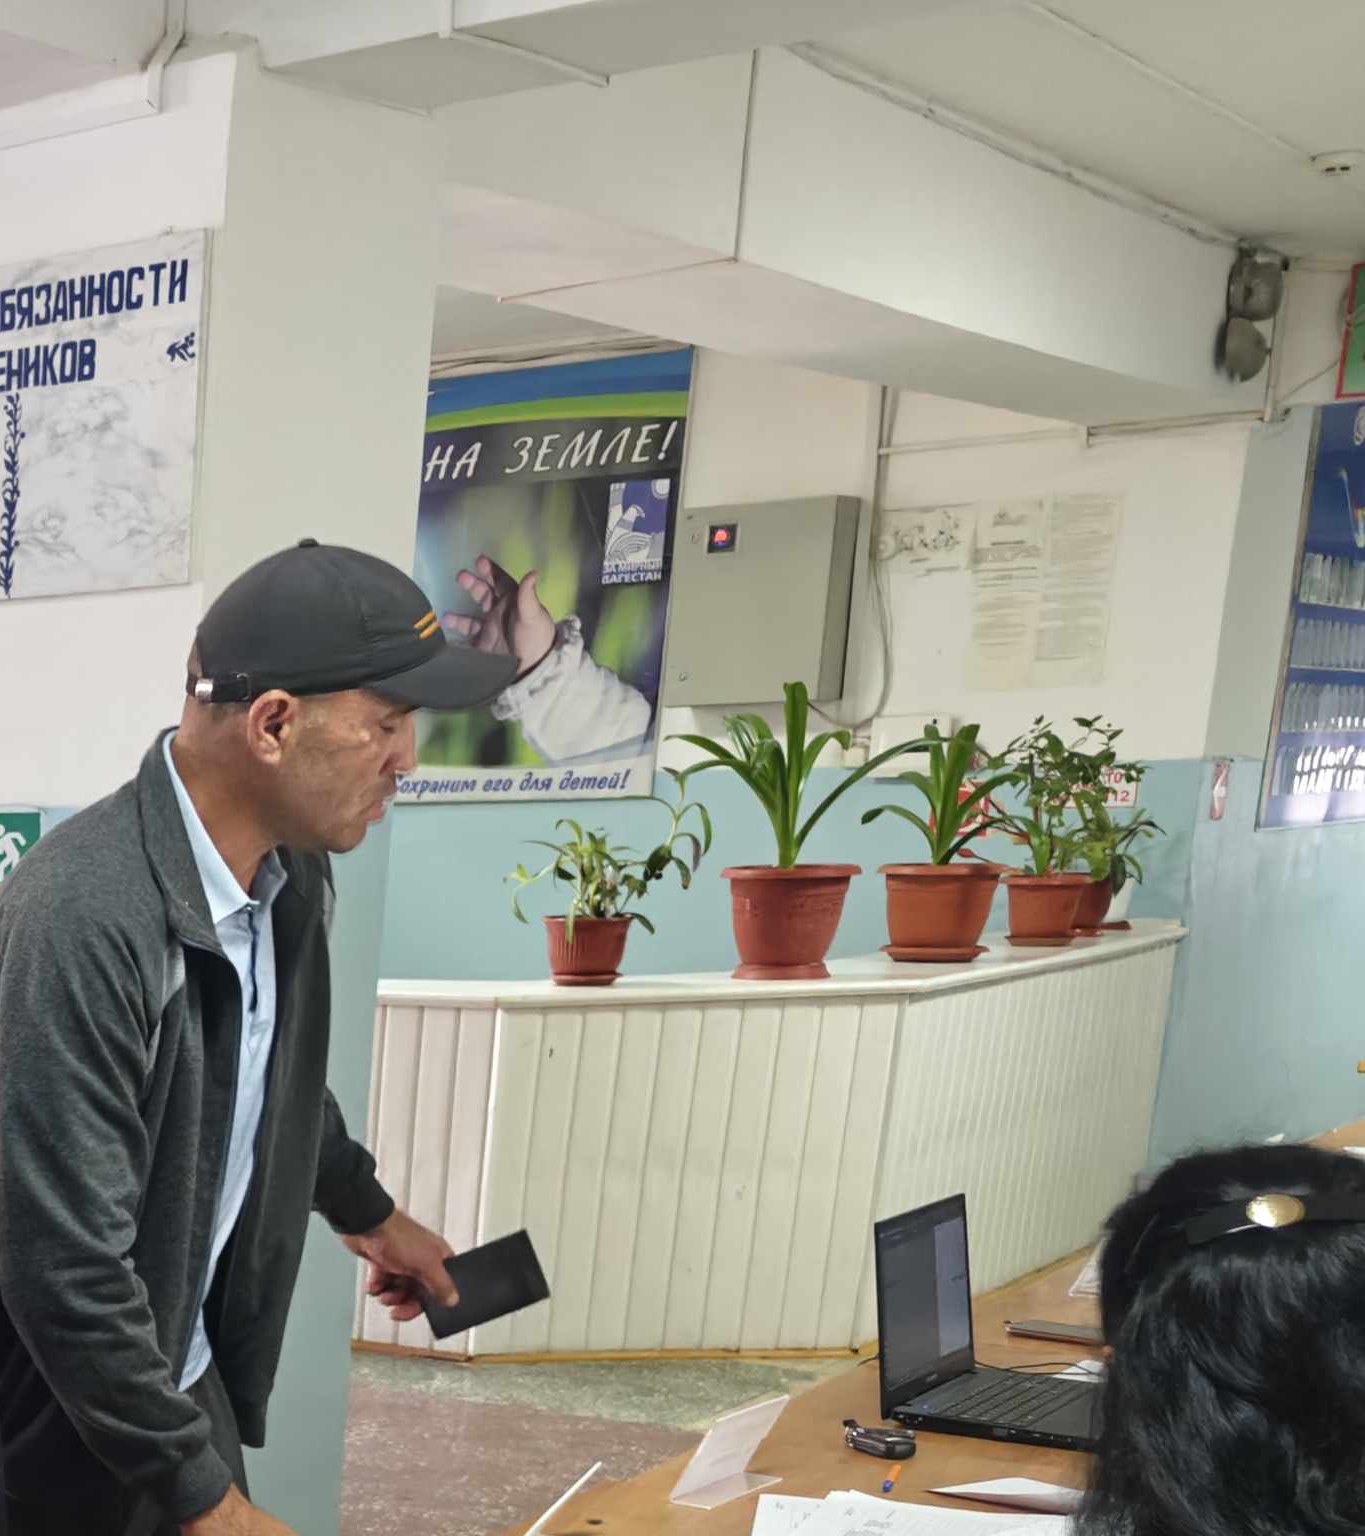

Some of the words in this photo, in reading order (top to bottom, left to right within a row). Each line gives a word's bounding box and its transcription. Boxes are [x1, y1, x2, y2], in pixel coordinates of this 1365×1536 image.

[424, 442, 483, 483] НА
[504, 420, 679, 475] ЗЕМЛЕ!
[483, 778, 513, 792] его
[519, 772, 552, 792] для
[558, 768, 632, 792] детей!
